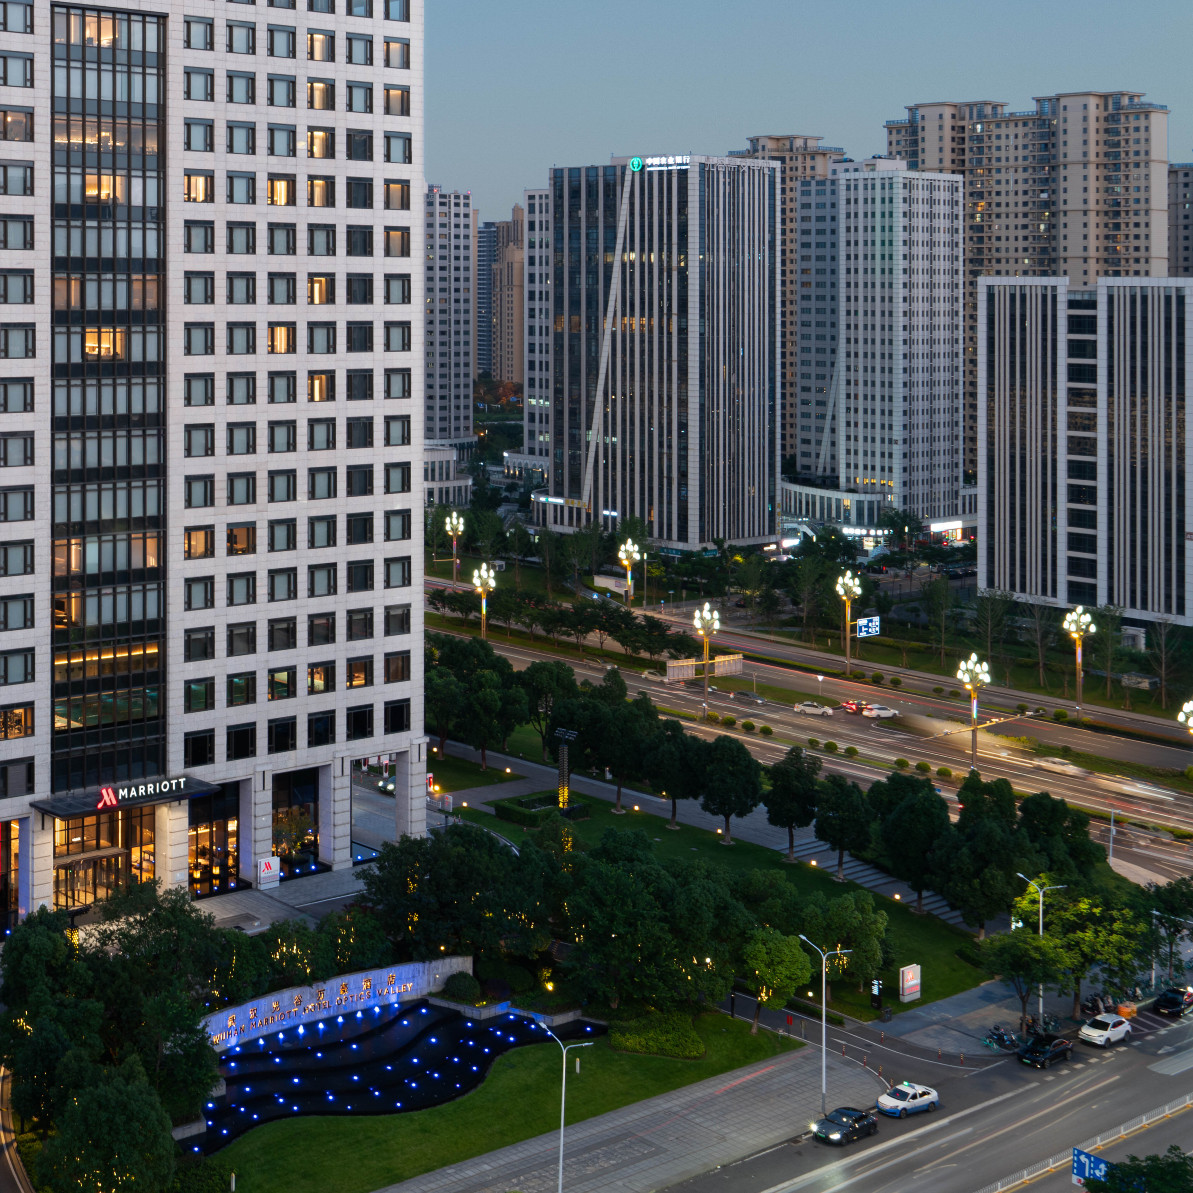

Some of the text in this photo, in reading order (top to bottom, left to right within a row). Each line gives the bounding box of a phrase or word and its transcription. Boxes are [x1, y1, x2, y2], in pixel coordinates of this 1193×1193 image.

[118, 777, 186, 800] MARRIOTT
[212, 982, 413, 1045] WUHAN MARRIOTT HOTEL OPTICS VALLEY
